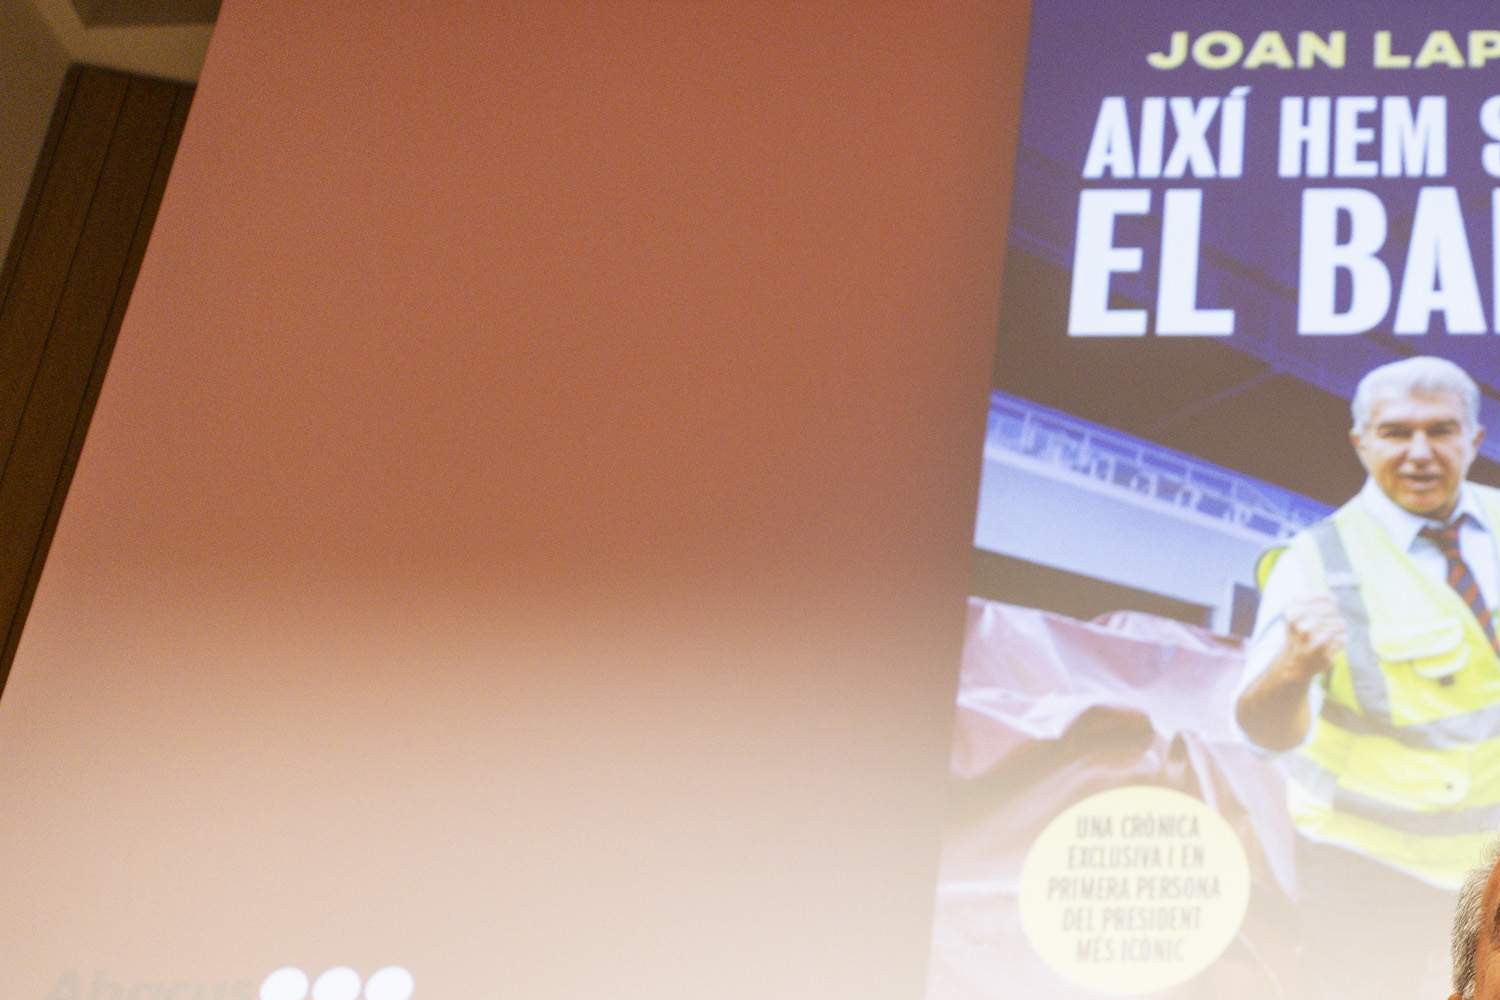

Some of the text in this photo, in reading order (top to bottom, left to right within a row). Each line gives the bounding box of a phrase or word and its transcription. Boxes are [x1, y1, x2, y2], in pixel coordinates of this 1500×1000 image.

[1147, 31, 1346, 69] JOAN
[1083, 87, 1250, 178] AIXÍ
[1278, 96, 1447, 177] HEM
[1068, 189, 1235, 336] EL
[1076, 815, 1113, 838] UNA
[1067, 845, 1162, 869] EXCLUSIVA
[1181, 845, 1205, 869] EN
[1047, 875, 1222, 901] PRIMERA PERSONA
[1062, 906, 1201, 932] DEL PRESIDENT
